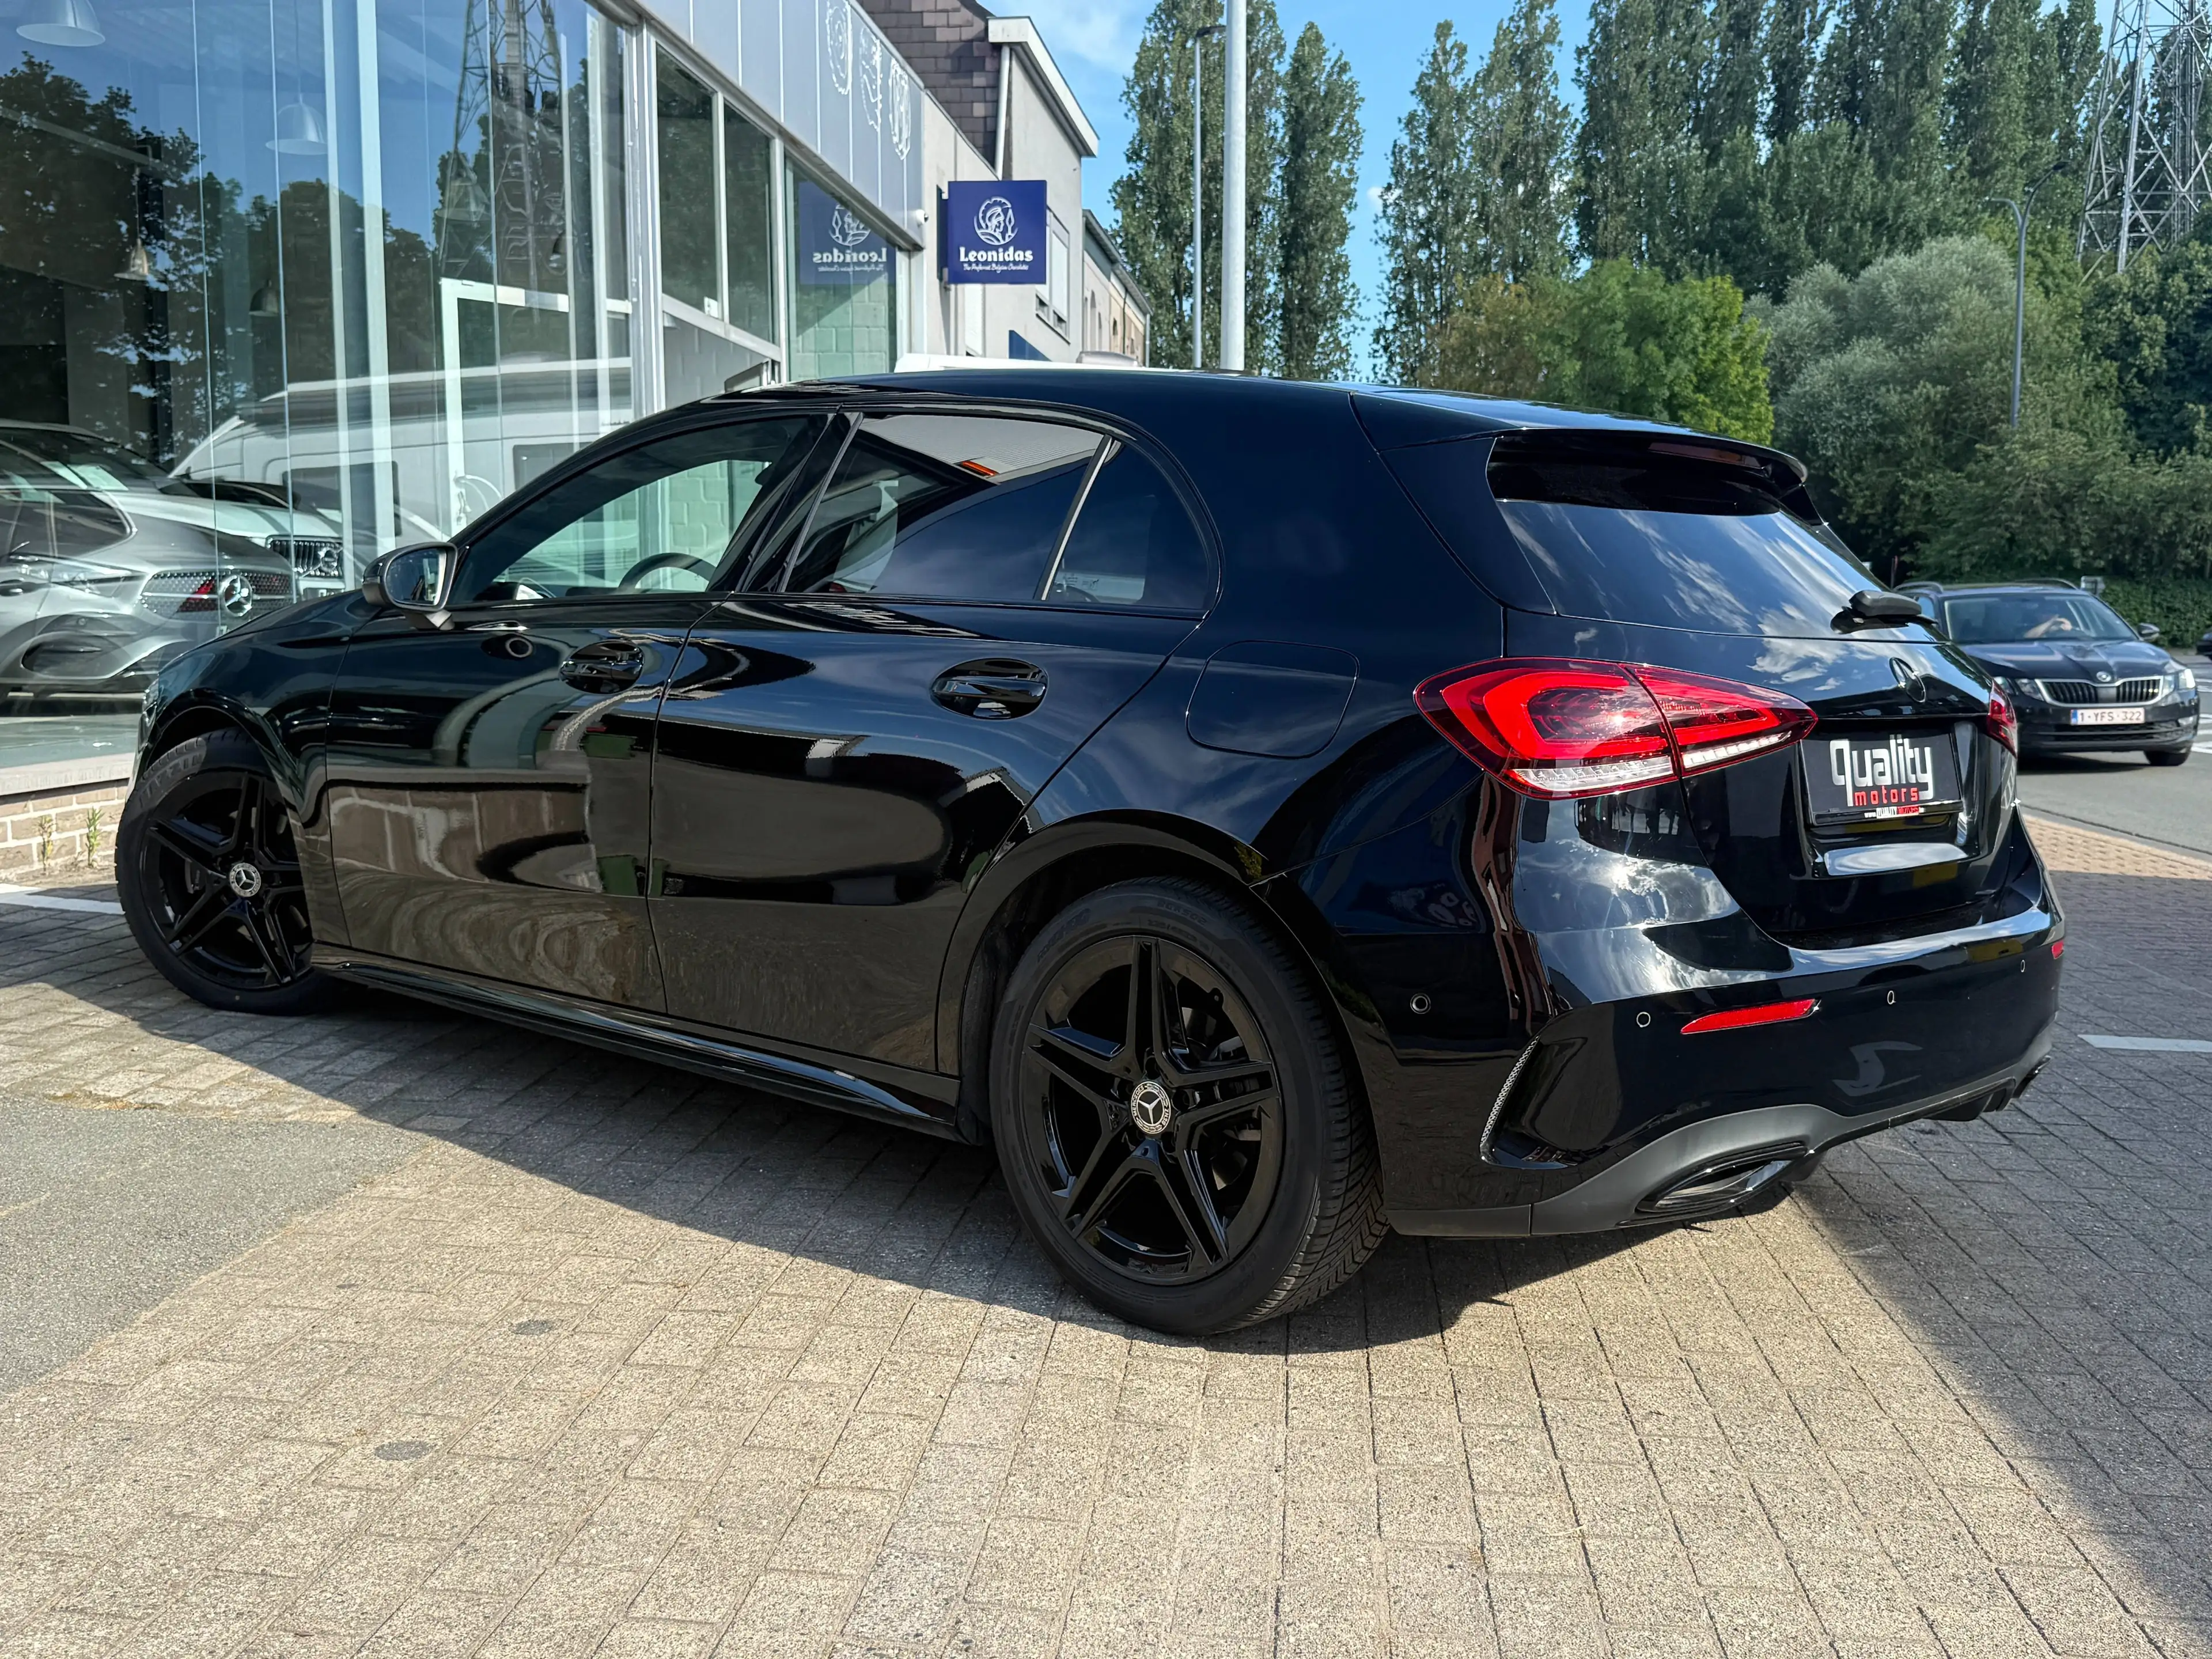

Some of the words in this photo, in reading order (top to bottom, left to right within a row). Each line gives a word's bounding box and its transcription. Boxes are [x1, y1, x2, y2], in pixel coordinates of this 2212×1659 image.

[960, 246, 1033, 262] Leonidas
[1854, 785, 1919, 806] motors
[1132, 1085, 1145, 1116] MERCEDES
[1161, 1108, 1169, 1126] BENZ
